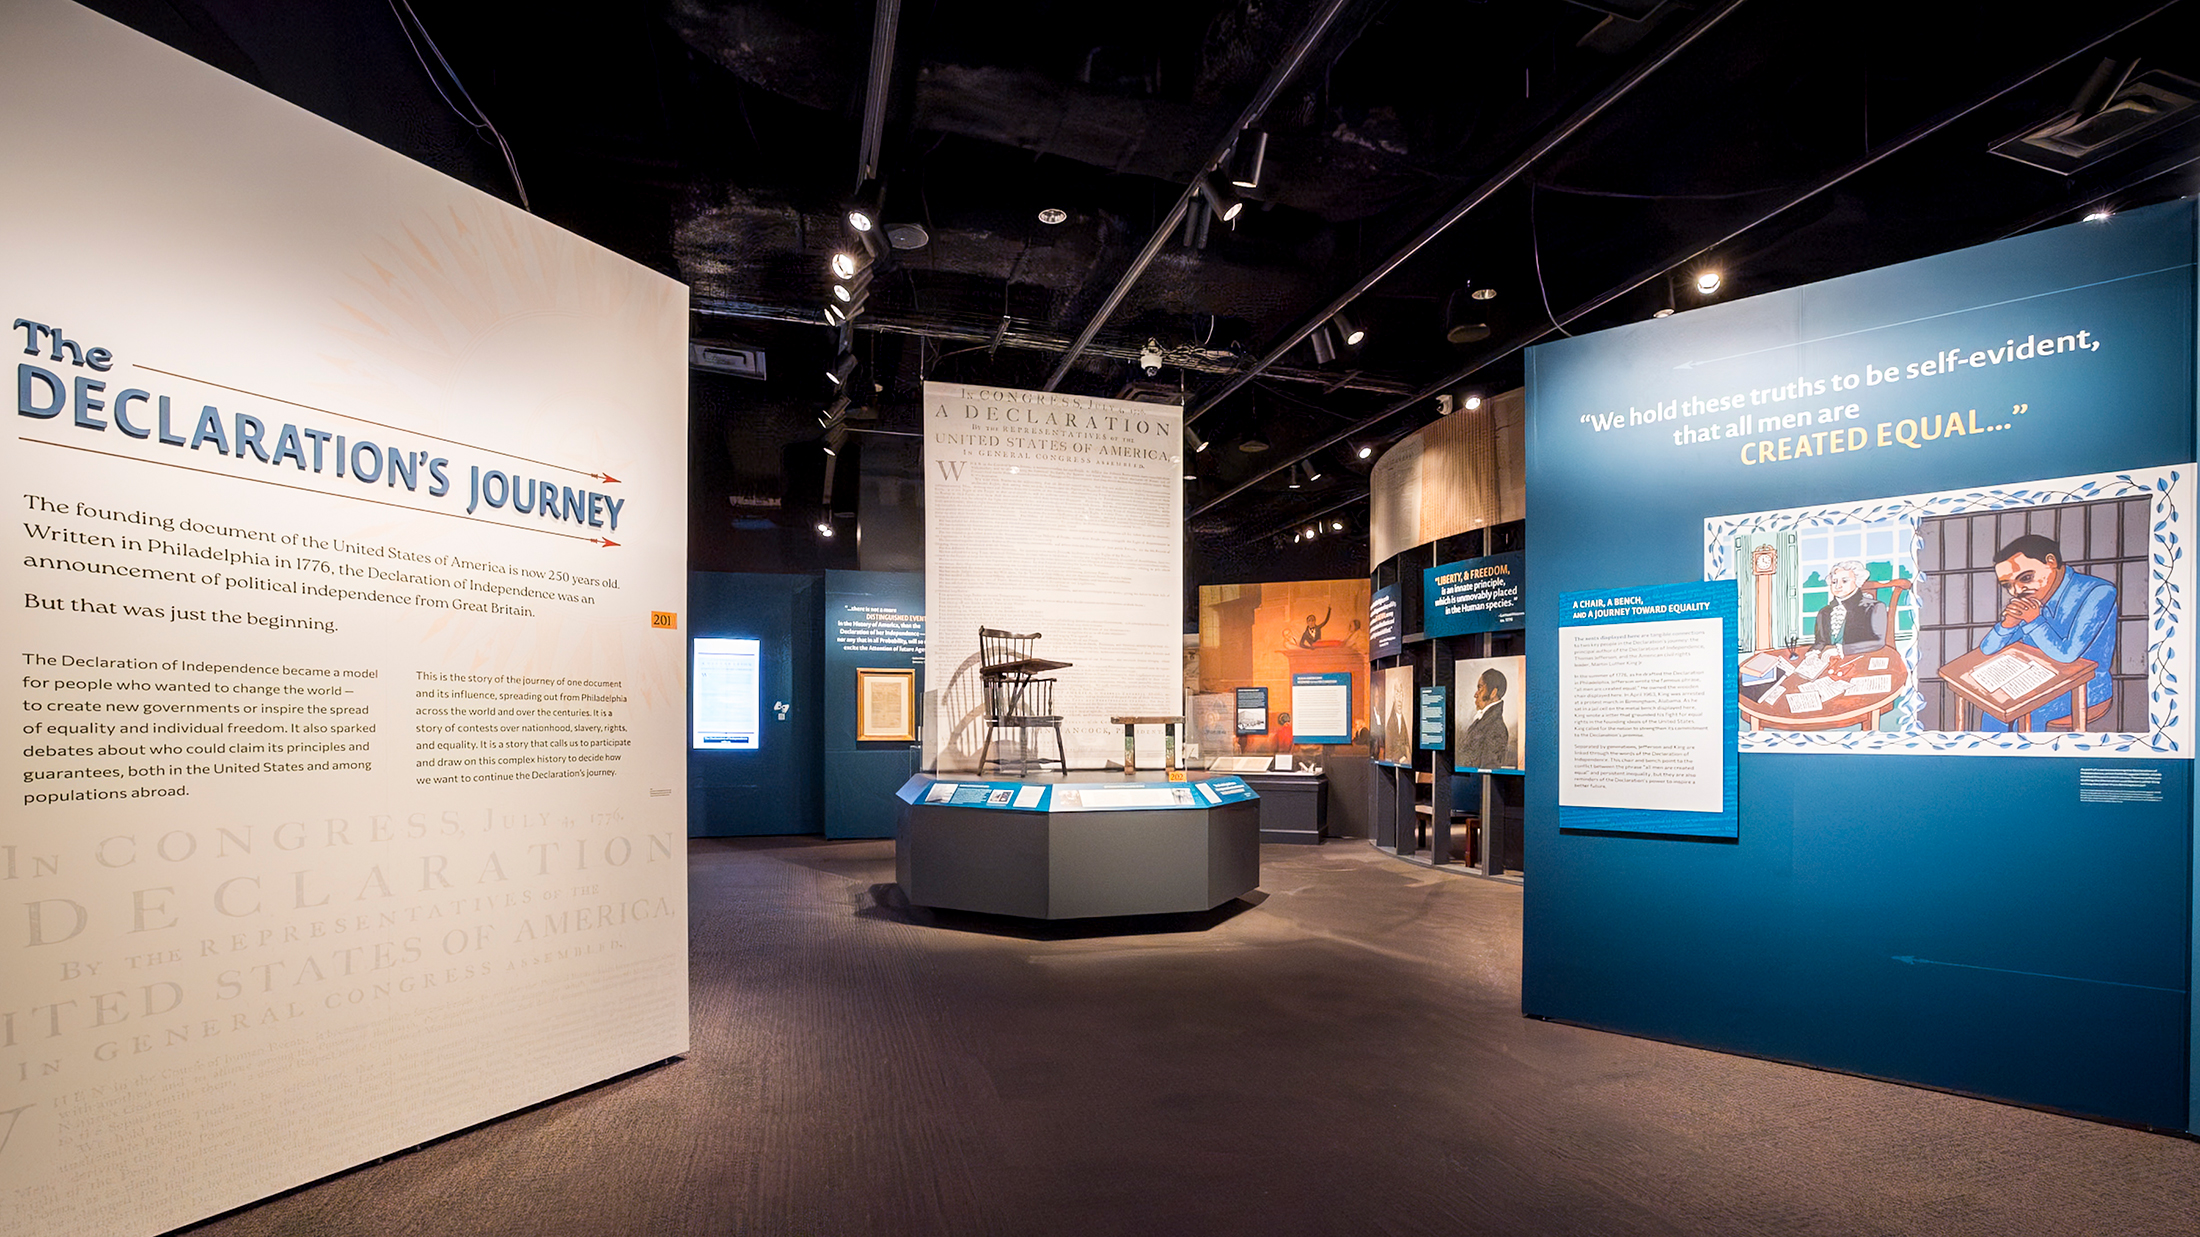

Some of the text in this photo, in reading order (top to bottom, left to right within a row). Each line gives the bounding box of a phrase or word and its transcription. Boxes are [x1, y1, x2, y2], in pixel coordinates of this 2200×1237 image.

[13, 318, 113, 372] The
[1580, 329, 2100, 432] “We hold these truths to be self-evident,
[980, 389, 1083, 409] CONGRESS,
[936, 404, 1171, 436] A DECLARATION
[1003, 426, 1107, 440] REPRESENTATIVES
[1673, 402, 1860, 446] that all men are
[18, 363, 625, 530] DECLARATION’S JOURNEY
[936, 433, 1171, 463] UNITED STATES OF AMERICA,
[979, 450, 1031, 460] GENERAL
[1036, 453, 1091, 464] CONGRESS
[1741, 426, 1868, 466] CREATED
[23, 494, 620, 589] The founding document of the United States of America is now 250 years old.
[1463, 571, 1469, 580] &
[1470, 564, 1510, 580] FREEDOM,
[1441, 577, 1506, 596] is an innate principle,
[1451, 596, 1456, 604] is
[1456, 589, 1492, 603] unmovably
[1493, 586, 1518, 599] placed
[24, 593, 338, 634] But that was just the beginning.
[1445, 606, 1451, 615] in
[1451, 605, 1461, 614] the
[1462, 603, 1485, 613] Human
[1573, 596, 1644, 609] A CHAIR, A BENCH,
[1594, 606, 1630, 619] JOURNEY
[1632, 604, 1667, 615] TOWARD
[1668, 602, 1711, 613] EQUALITY
[653, 614, 671, 626] 201
[866, 613, 909, 621] DISTINGUISHED
[22, 653, 57, 666] The
[62, 655, 158, 670] Declaration
[162, 659, 178, 671] of
[182, 660, 279, 675] Independence
[282, 665, 331, 677] became
[343, 669, 378, 679] model
[416, 671, 438, 681] This
[440, 672, 448, 681] is
[450, 673, 466, 682] the
[468, 675, 493, 685] story
[494, 674, 504, 683] of
[506, 675, 521, 684] the
[522, 676, 555, 687] journey
[556, 677, 565, 686] of
[583, 679, 622, 688] document
[416, 689, 435, 698] and
[437, 689, 449, 699] its
[451, 689, 497, 700] influence,
[499, 692, 542, 703] spreading
[560, 692, 580, 701] from
[581, 693, 627, 703] Philadelphia
[1, 845, 59, 880] IN
[95, 810, 465, 868] CONGRESS,
[483, 808, 550, 833] JULY
[22, 832, 673, 948] DECLARATION
[60, 884, 599, 982] BY THE REPRESENTATIVES OF THE
[2, 897, 675, 1048] ITED STATES OF AMERICA,
[18, 1059, 62, 1082] IN
[93, 1002, 304, 1062] GENERAL
[325, 961, 491, 1009] CONGRESS
